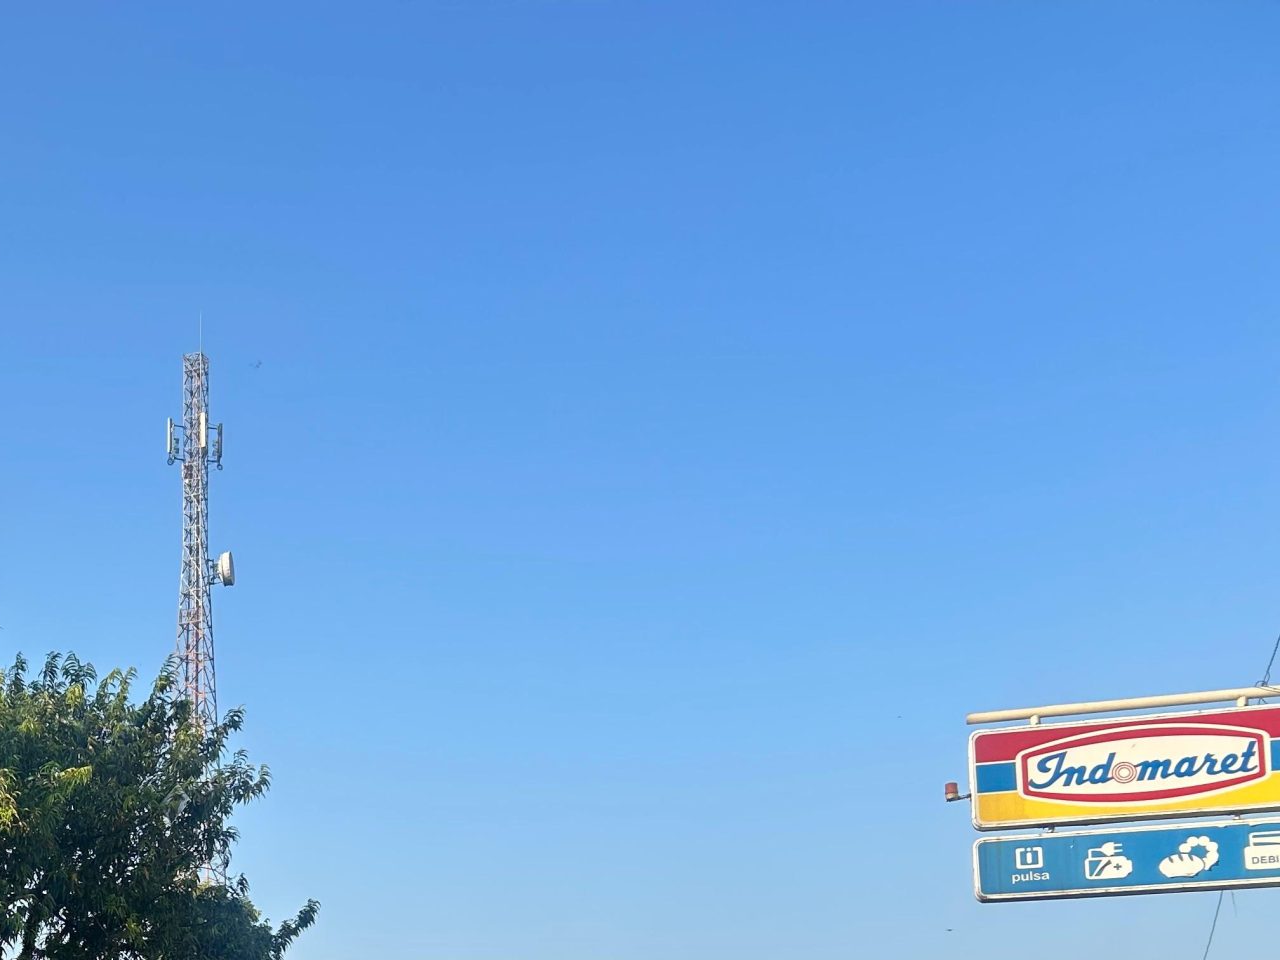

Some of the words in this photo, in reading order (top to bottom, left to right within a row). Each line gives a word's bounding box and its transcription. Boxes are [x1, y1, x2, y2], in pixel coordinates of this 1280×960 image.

[1028, 740, 1258, 789] Indomaret
[1251, 855, 1280, 865] DEBI
[1012, 870, 1050, 884] pulsa
